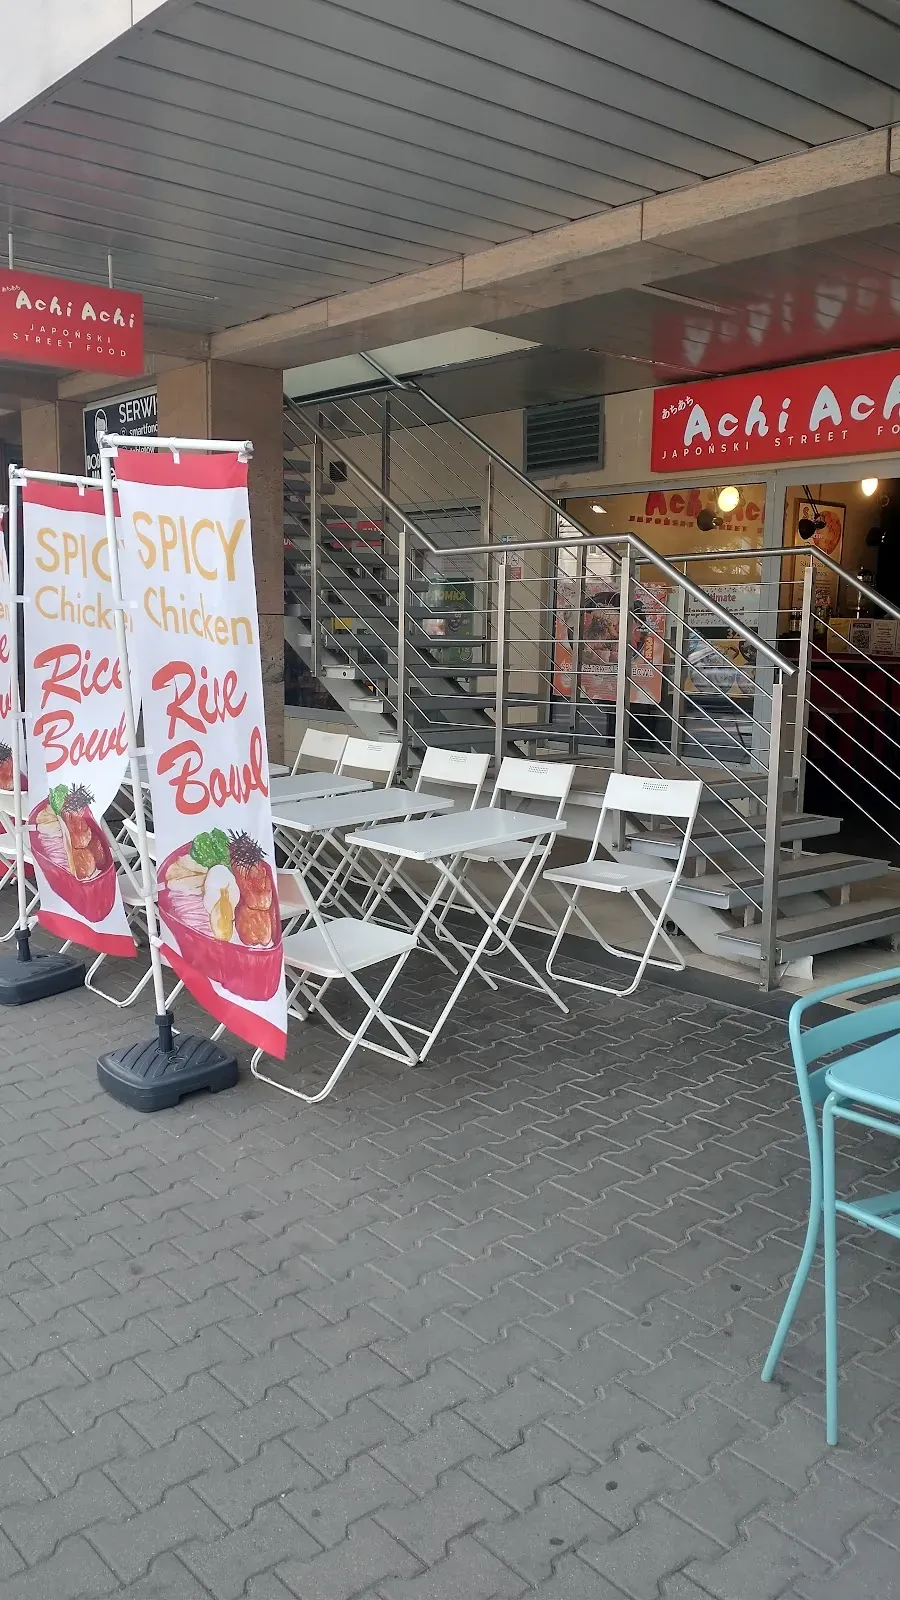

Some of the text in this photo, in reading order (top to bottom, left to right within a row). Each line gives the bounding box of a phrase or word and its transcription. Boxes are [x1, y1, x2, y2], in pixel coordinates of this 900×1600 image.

[15, 290, 135, 328] Achi Achi
[12, 333, 126, 357] STREET FOOD
[30, 324, 111, 344] JAPOŃSKI
[119, 395, 158, 423] SERWI
[661, 396, 694, 420] あちあち
[683, 394, 791, 447] Achi
[662, 441, 749, 460] JAPOŃSKI
[774, 430, 848, 447] STREET
[35, 527, 125, 583] SPIC
[132, 511, 246, 582] SPICY
[143, 586, 254, 646] Chicken
[151, 660, 248, 740] Rice
[156, 726, 269, 815] Bowl
